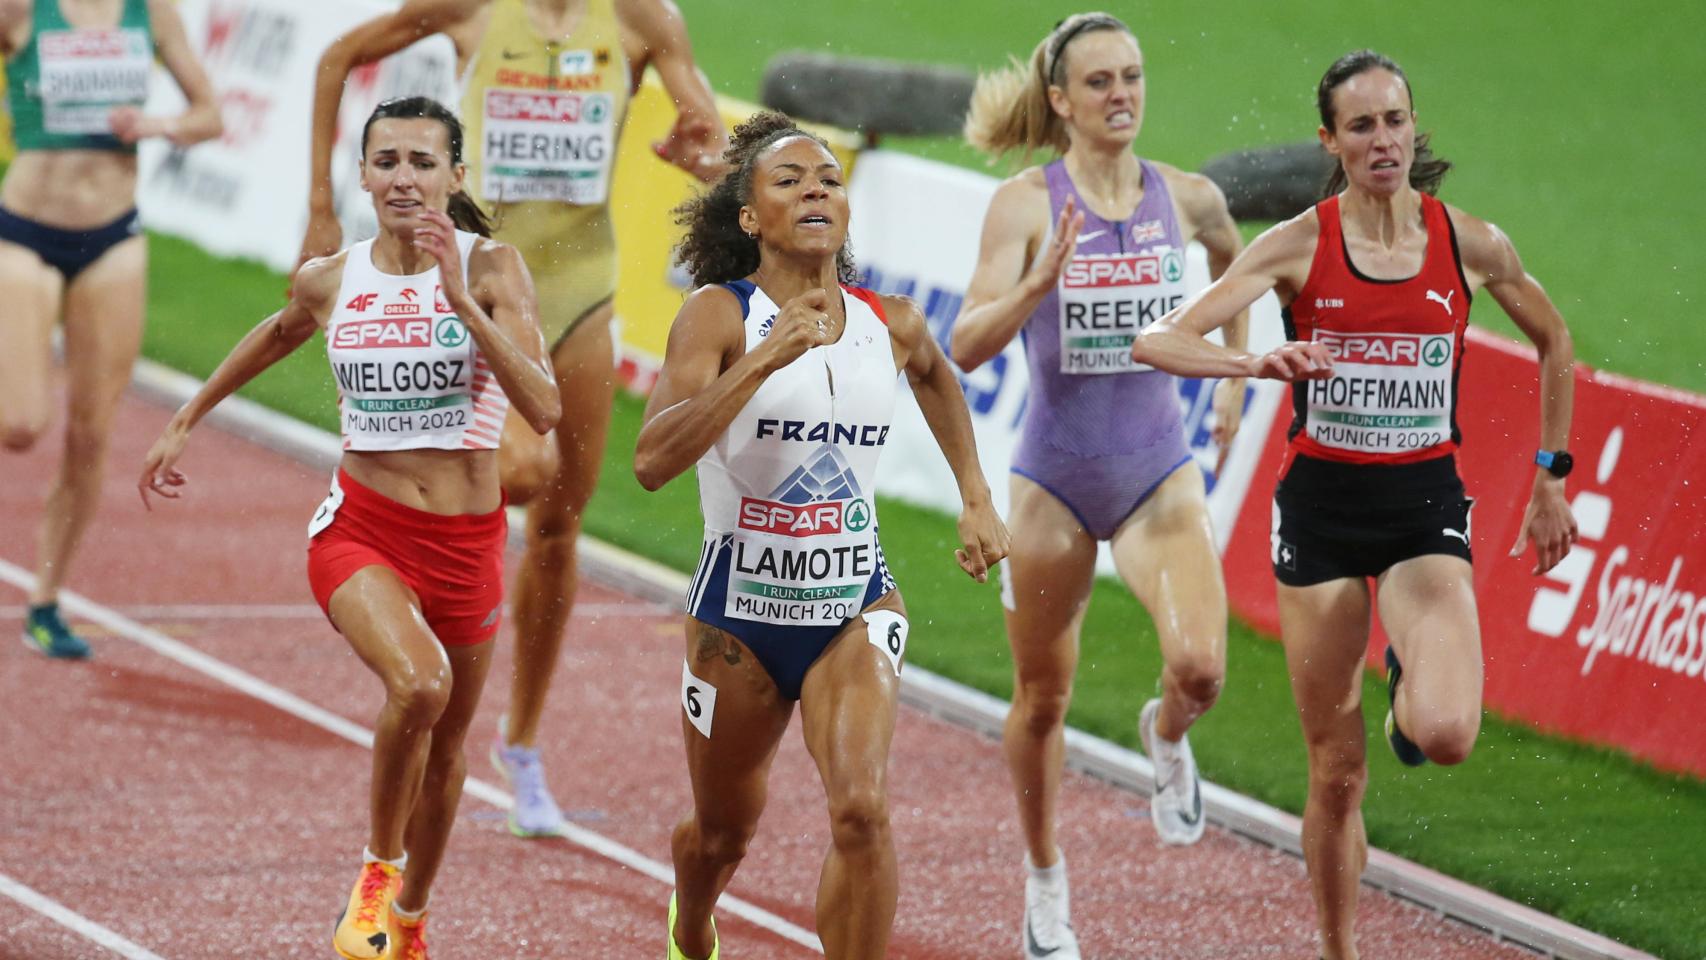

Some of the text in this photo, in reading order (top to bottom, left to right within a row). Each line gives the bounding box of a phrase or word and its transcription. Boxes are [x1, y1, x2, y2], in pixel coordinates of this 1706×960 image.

[489, 93, 577, 120] SPAR
[486, 132, 604, 162] HERING
[1066, 258, 1159, 286] SPAR
[384, 305, 418, 315] ORLEN
[1325, 298, 1344, 308] UBS
[335, 321, 430, 347] SPAR
[1318, 337, 1417, 363] SPAR
[333, 360, 466, 393] WIELGOSZ
[368, 399, 394, 411] RUN
[396, 397, 436, 411] CLEAN
[1312, 376, 1446, 409] HOFFMANN
[347, 409, 467, 433] MUNICH 2022
[1348, 415, 1374, 426] RUN
[1377, 416, 1416, 427] CLEAN
[1316, 425, 1442, 448] MUNICH 2022
[742, 503, 840, 532] SPAR
[735, 541, 871, 581] LAMOTE
[770, 585, 798, 599] RUN
[735, 596, 852, 620] MUNICH 20
[887, 621, 902, 656] 6
[686, 685, 702, 718] 6
